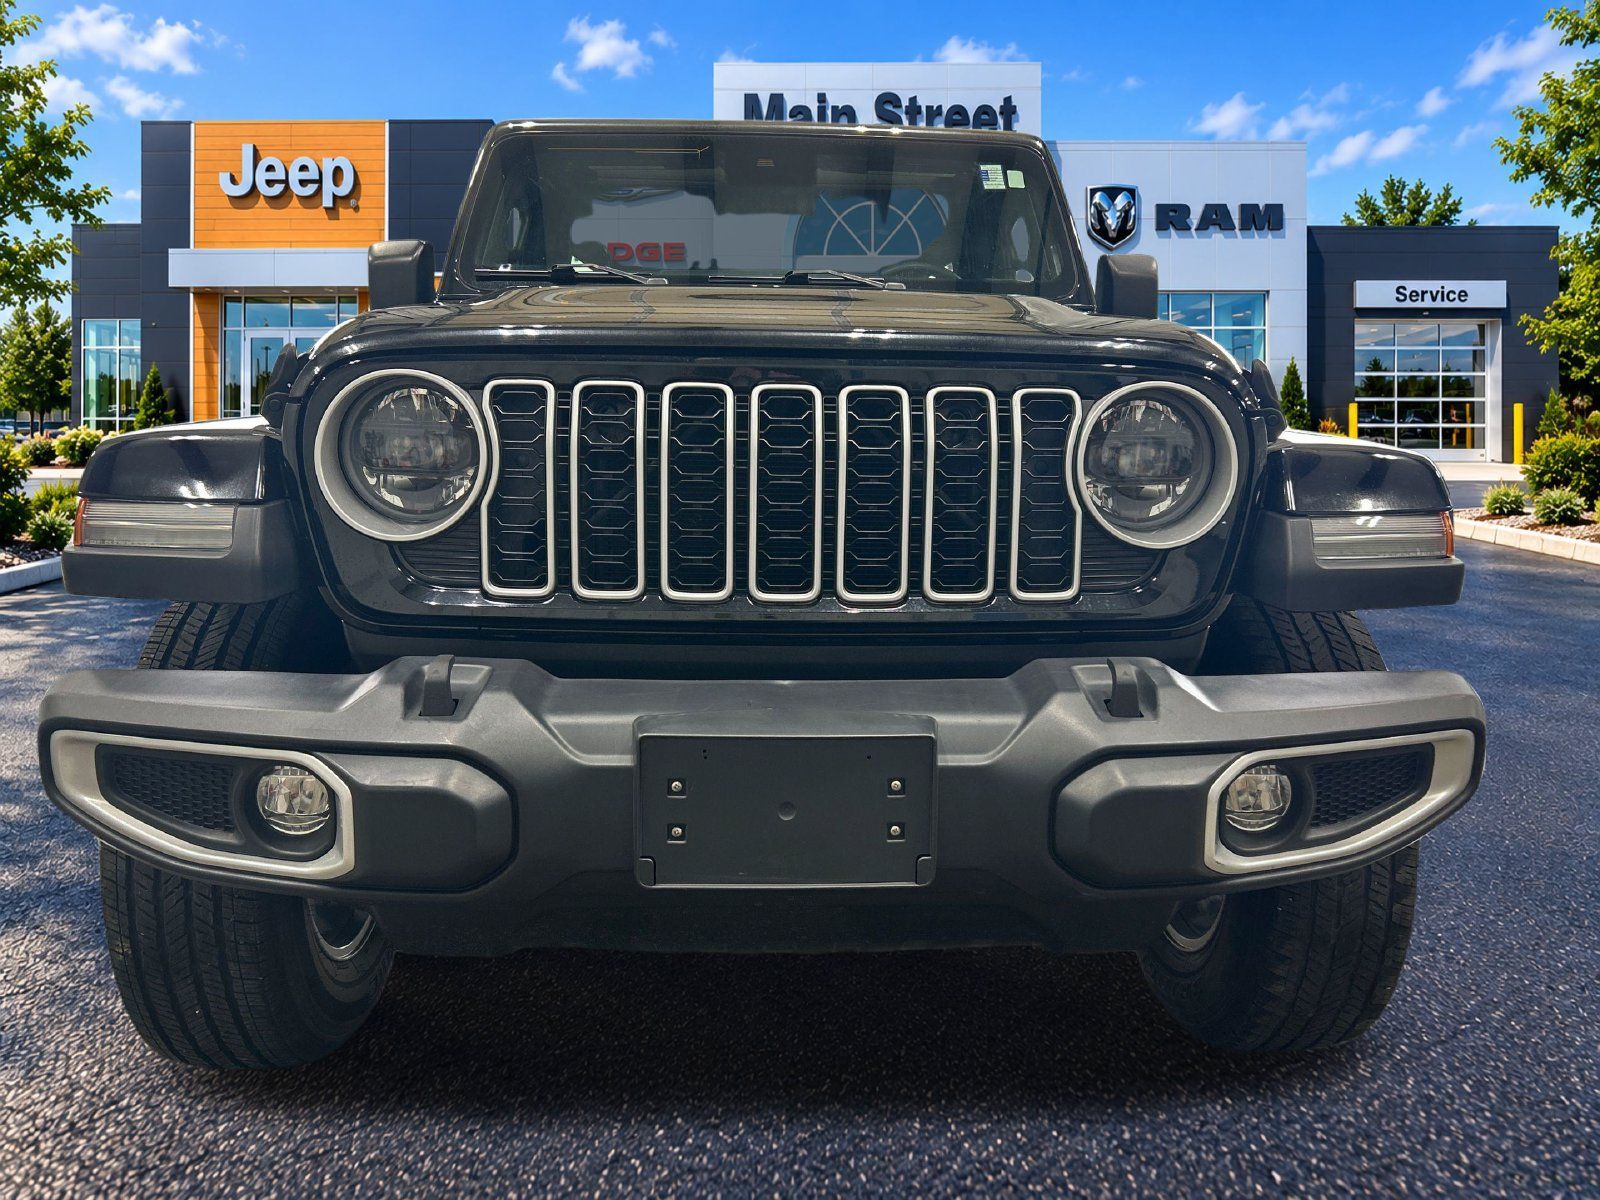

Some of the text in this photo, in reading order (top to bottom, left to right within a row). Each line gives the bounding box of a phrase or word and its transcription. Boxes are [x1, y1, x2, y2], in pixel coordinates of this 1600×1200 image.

[744, 92, 1017, 131] Main Street
[218, 143, 355, 208] Jeep
[1155, 203, 1283, 231] RAM
[607, 242, 686, 262] DGE
[1395, 285, 1468, 302] Service
